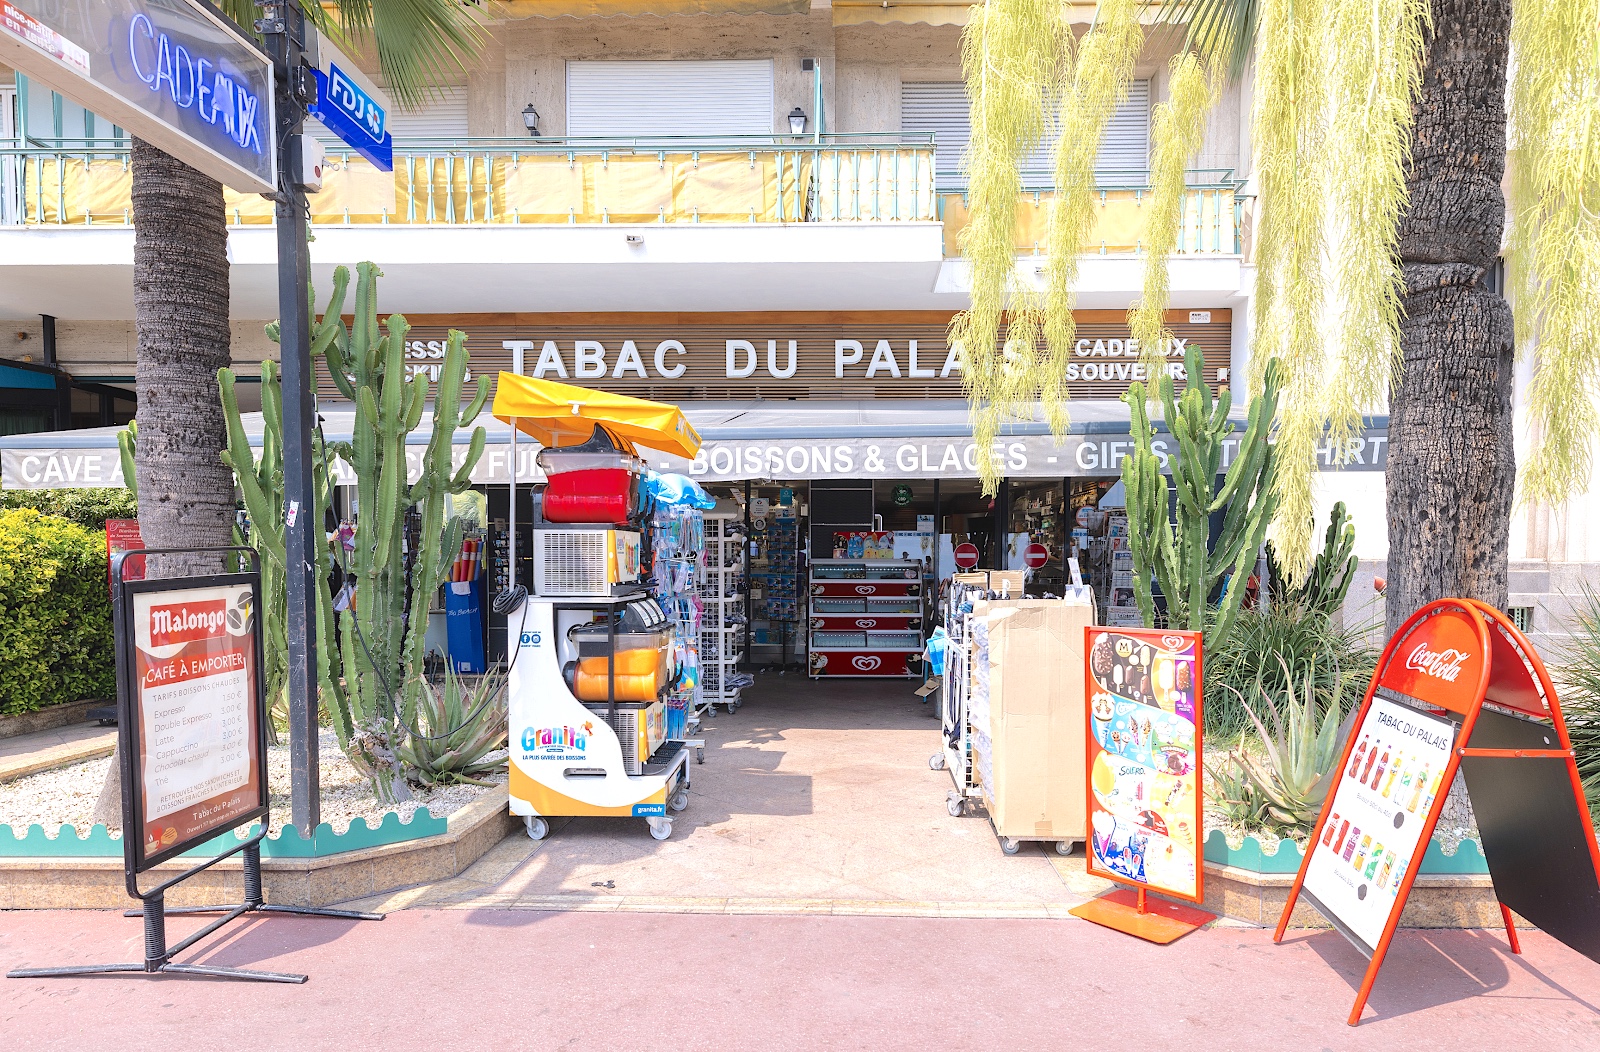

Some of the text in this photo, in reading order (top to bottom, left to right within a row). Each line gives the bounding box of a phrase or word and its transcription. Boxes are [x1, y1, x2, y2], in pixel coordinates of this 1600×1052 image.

[6, 17, 20, 32] en
[332, 71, 365, 120] FDJ
[503, 339, 687, 379] TABAC
[725, 339, 798, 379] DU
[834, 339, 1031, 379] PALAS
[21, 455, 102, 483] CAVE
[688, 445, 854, 475] BOISSONS
[864, 444, 885, 473] &
[1075, 441, 1169, 470] GIFS
[152, 607, 225, 635] Malongo
[146, 652, 243, 683] CAFÉ À EMPORTER
[1405, 642, 1472, 683] Coca-Cola
[152, 676, 240, 702] TARIFS BOISSONS CHAUDES
[154, 705, 186, 720] Expresso
[154, 720, 180, 733] Double
[182, 712, 213, 726] Expresso
[155, 735, 175, 747] Latte
[521, 725, 586, 751] Granita
[1377, 711, 1449, 751] TABAC DU PALAIS
[156, 741, 199, 760] Cappuccino
[156, 796, 185, 813] BOISSONS
[160, 786, 194, 804] RETROUVEZ
[194, 782, 205, 792] NOS
[192, 809, 213, 821] Tabac
[637, 806, 663, 814] granita.fr
